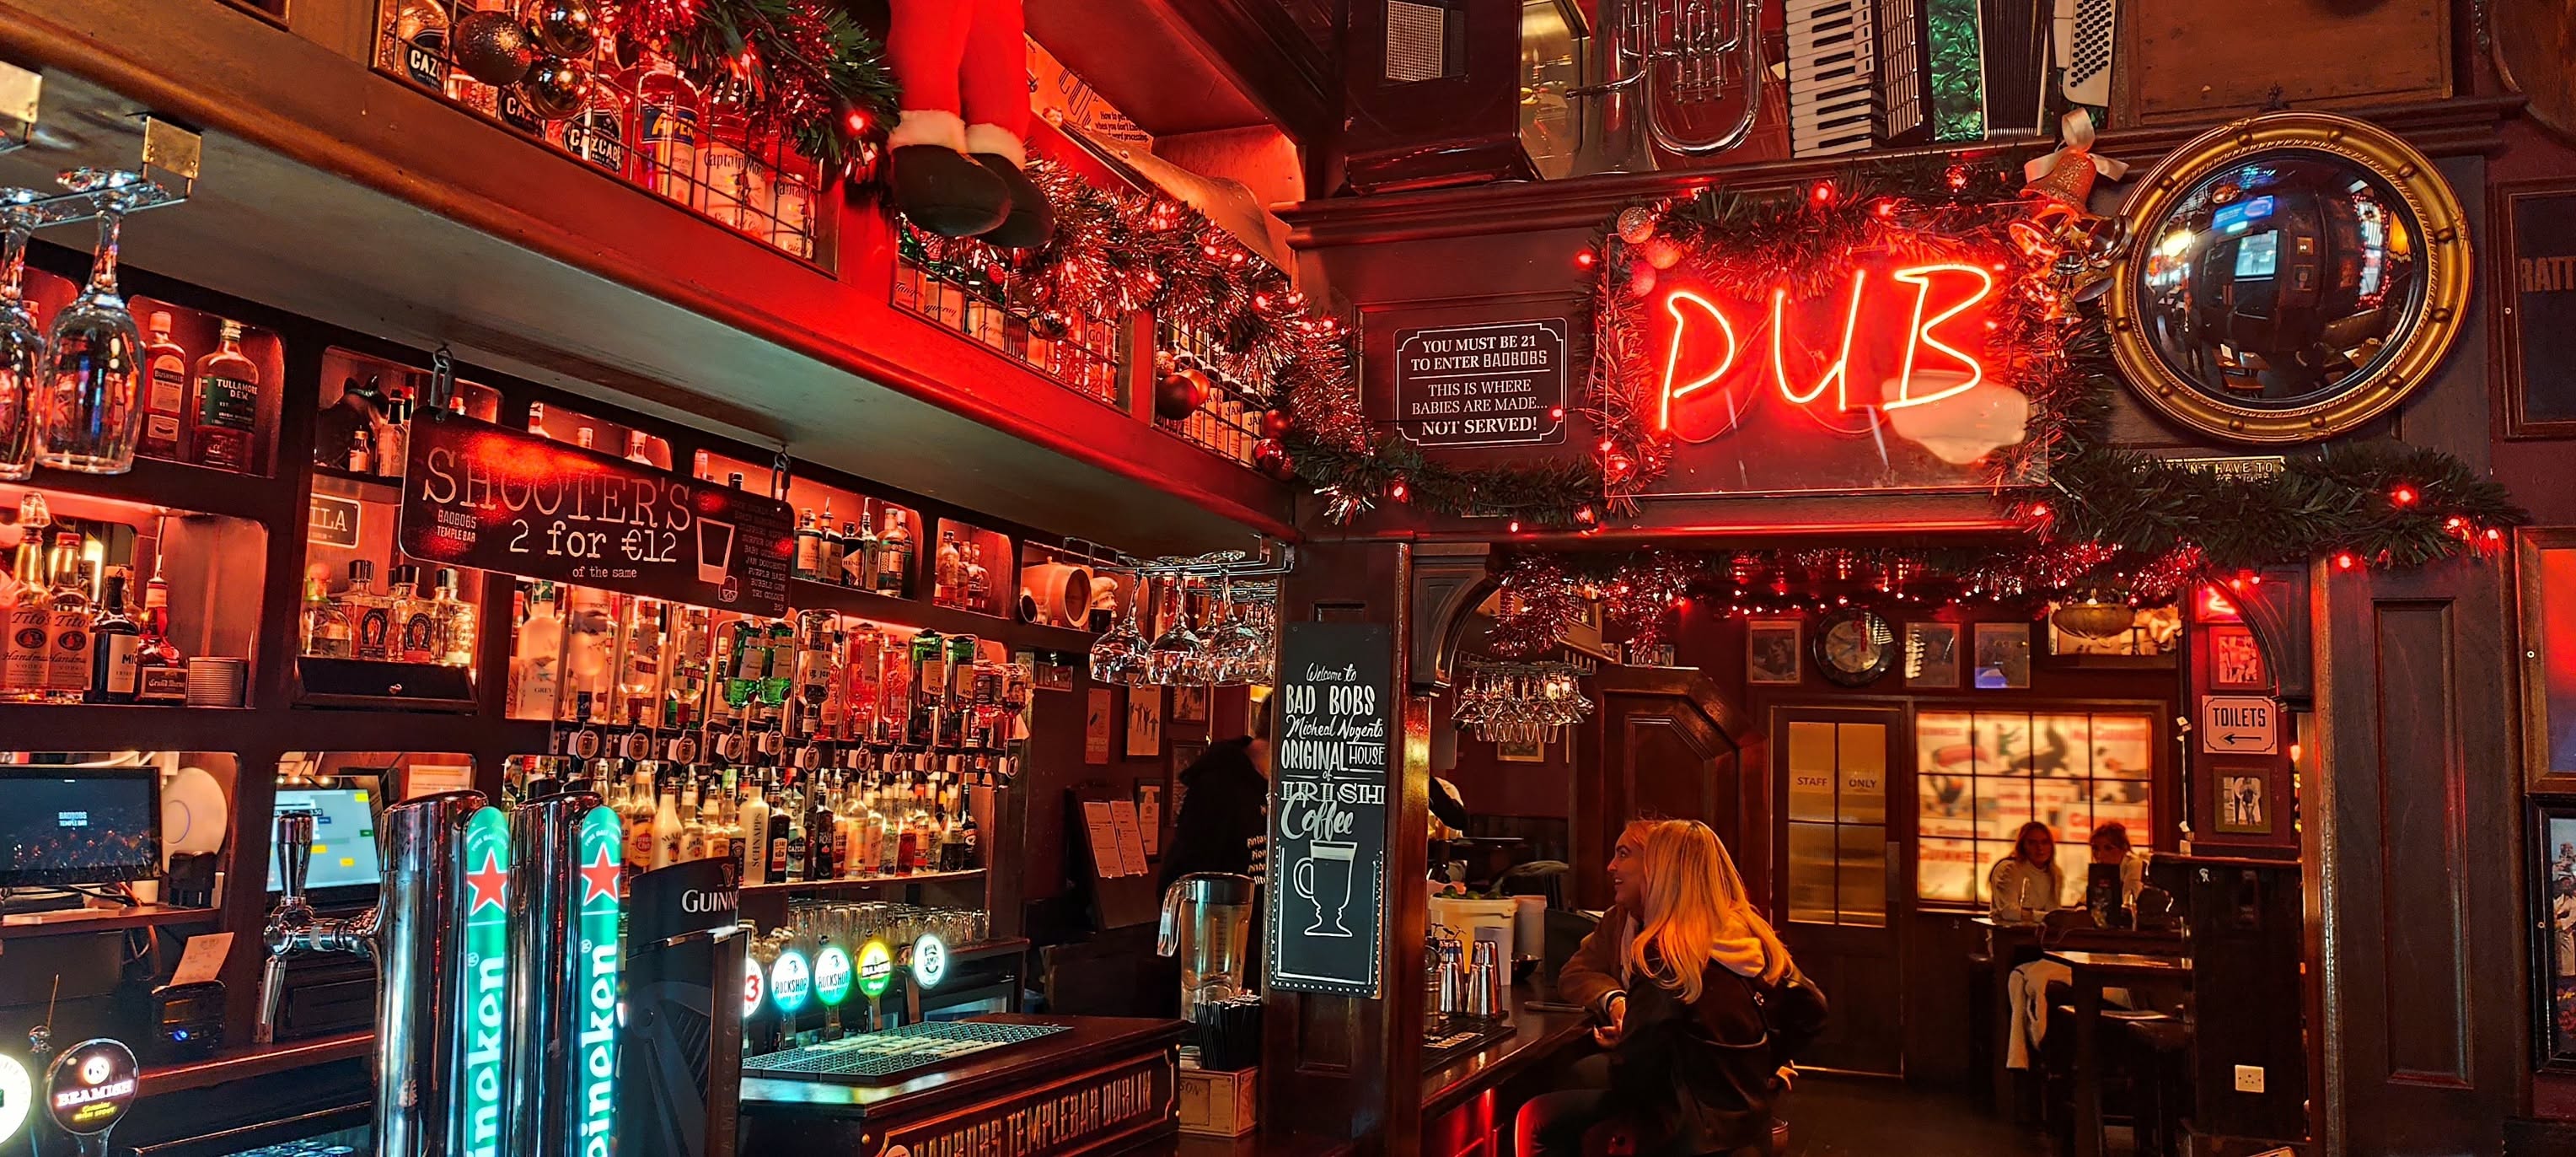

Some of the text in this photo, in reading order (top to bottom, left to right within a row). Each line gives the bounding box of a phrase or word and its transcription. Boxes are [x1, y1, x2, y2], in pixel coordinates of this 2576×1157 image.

[1422, 335, 1537, 353] YOU MUST BE 21
[1661, 263, 1992, 430] PUB
[1411, 350, 1548, 371] TO ENTER BADBOBS
[216, 378, 258, 396] TULLAMORE
[1428, 379, 1532, 397] THIS IS WHERE
[1412, 400, 1460, 415] BABIES
[1462, 399, 1491, 413] ARE
[1421, 416, 1538, 435] NOT SERVED!
[2215, 462, 2250, 473] HAVE
[2257, 461, 2273, 472] TO
[422, 446, 690, 531] SHOOTER'S
[437, 509, 477, 530] BADBOBS
[437, 525, 476, 543] TEMPLE BAR
[509, 519, 677, 562] 2 for €12
[572, 566, 637, 578] of the same
[12, 611, 51, 627] Tito's
[1307, 662, 1357, 682] Welcome to
[1285, 684, 1375, 716] BAD BOBS
[2213, 707, 2266, 727] TOILETS
[1280, 739, 1386, 772] ORIGINAL HOUSE
[1322, 768, 1333, 782] of
[1797, 776, 1877, 789] STAFF ONLY
[1280, 781, 1386, 805] IRISH
[1280, 790, 1354, 842] Coffee
[751, 812, 762, 869] SCHNAPPS
[467, 951, 505, 1157] ineken
[582, 939, 618, 1157] eineken
[56, 1079, 134, 1107] BEAMISH
[1103, 1069, 1152, 1127] DUBLIN
[94, 1106, 117, 1118] STOUT
